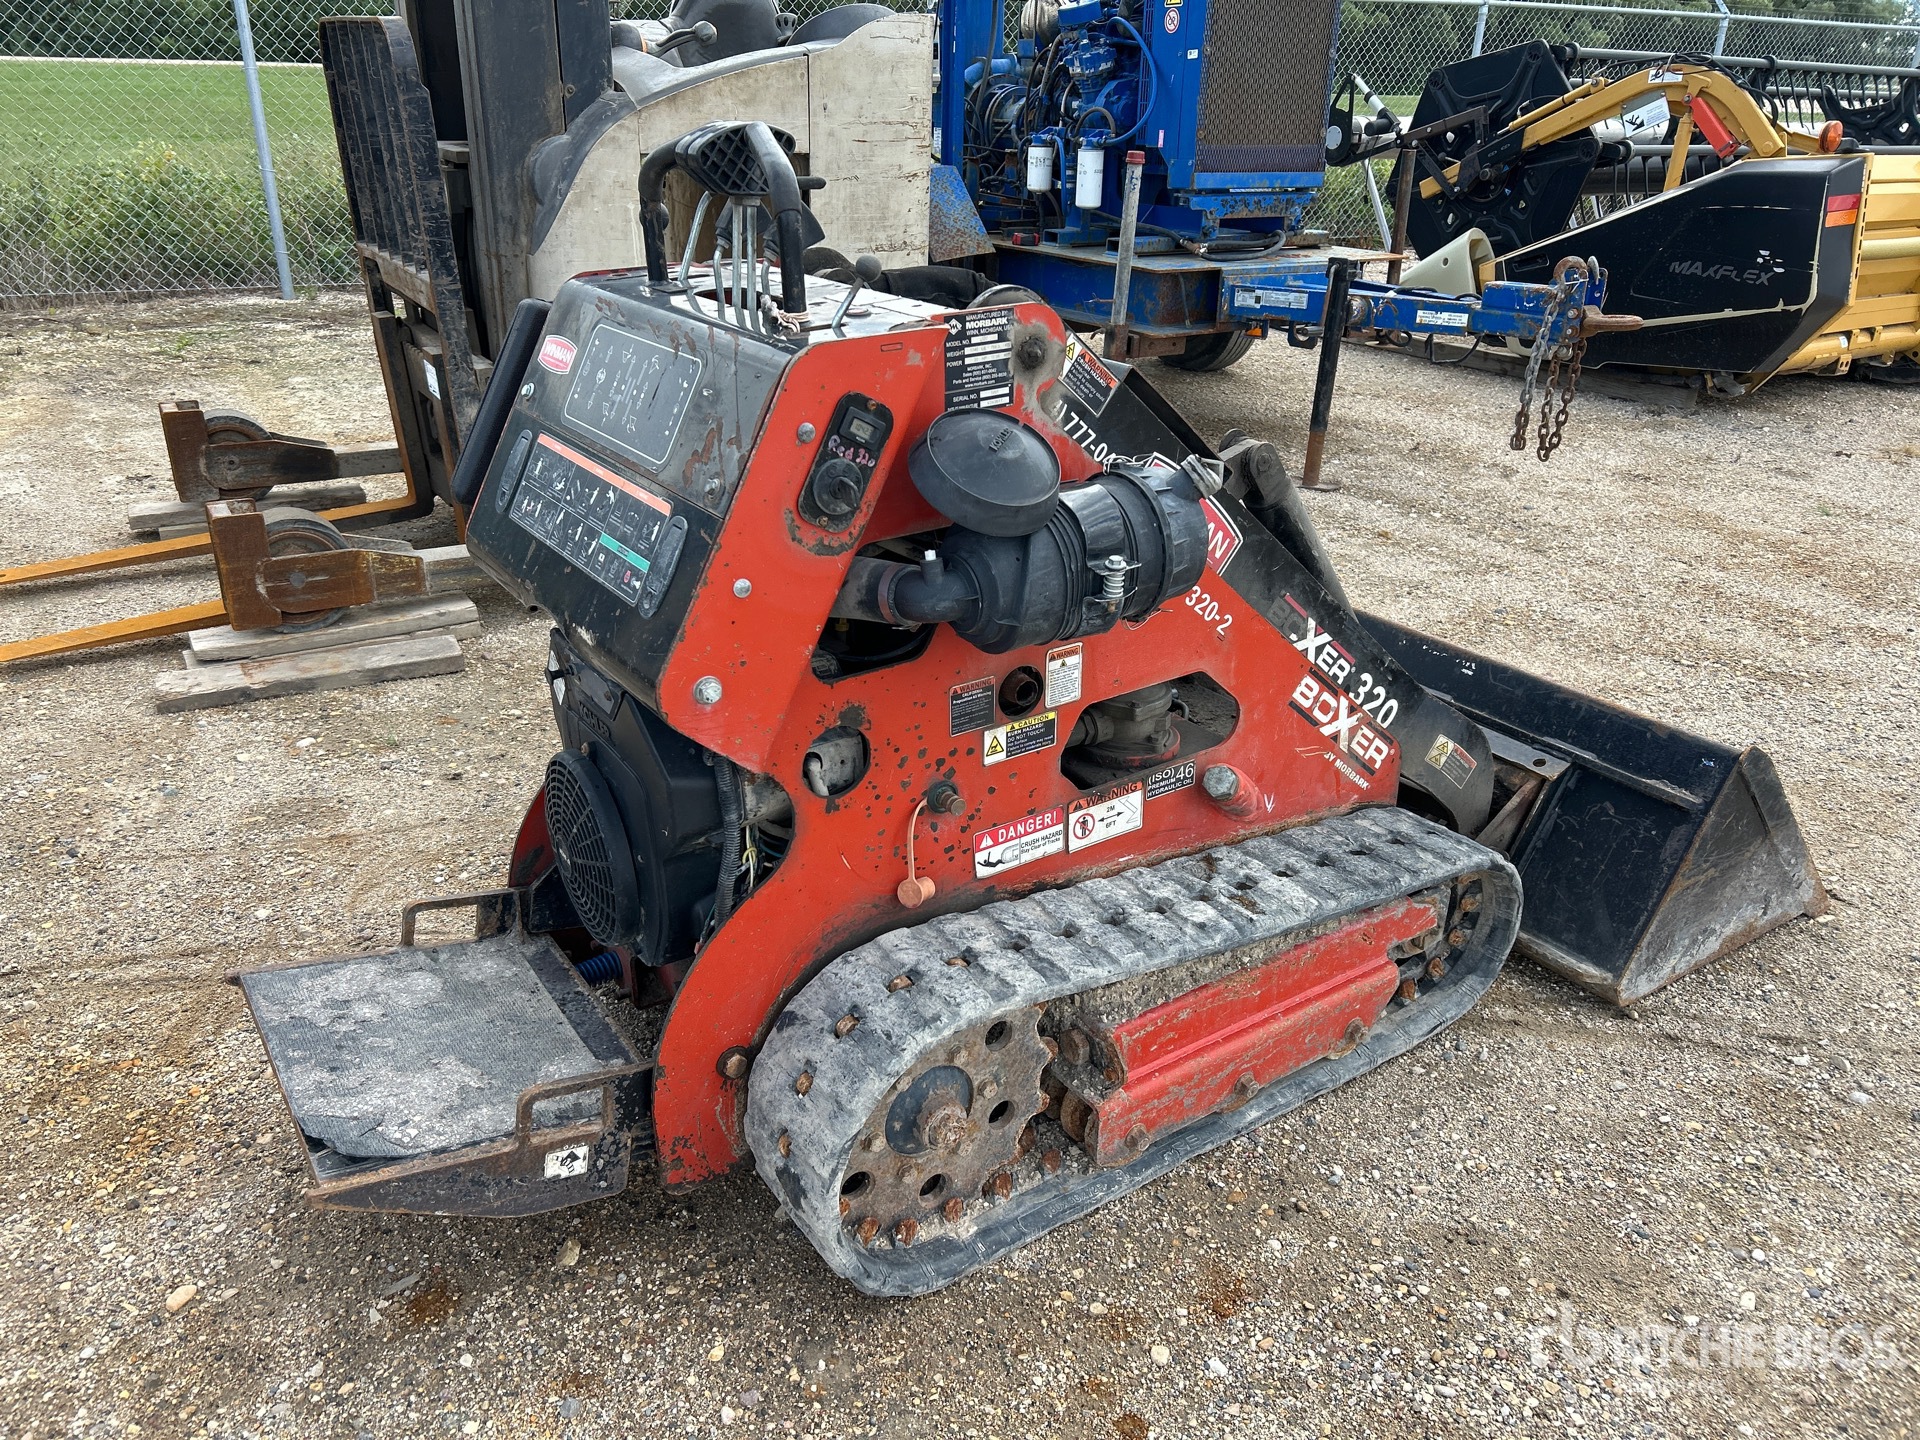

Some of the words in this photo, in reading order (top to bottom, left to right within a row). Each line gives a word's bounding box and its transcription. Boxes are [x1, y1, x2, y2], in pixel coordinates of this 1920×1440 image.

[1669, 260, 1776, 286] MAXFLEX
[966, 311, 1001, 320] MANUFACTURED
[966, 317, 1008, 329] MORBARK
[946, 340, 961, 348] MODEL
[946, 349, 964, 357] WEIGHT
[1077, 356, 1091, 371] CRUSH
[1087, 355, 1113, 385] WARNING
[828, 435, 854, 461] Red
[856, 448, 876, 467] 320
[1185, 585, 1233, 636] 320-2
[1056, 647, 1079, 659] WARNING
[959, 680, 992, 692] WARNING
[962, 688, 983, 698] CALIFORNIA
[1349, 672, 1399, 729] 320
[578, 701, 612, 739] KOHLER
[1018, 714, 1049, 728] CAUTION
[1291, 674, 1390, 769] BOXER
[1007, 729, 1022, 737] BURN
[1022, 723, 1044, 732] HAZARD!
[1027, 728, 1045, 736] TOUCH!
[1148, 767, 1175, 785] (ISO)
[1176, 763, 1194, 780] 46
[1334, 758, 1369, 791] MORBARK
[1147, 777, 1176, 790] PREMIUM
[1147, 781, 1182, 797] HYDRAULIC
[1086, 783, 1138, 807] WARNING
[1106, 805, 1115, 813] 2M
[998, 811, 1057, 842] DANGER!
[1105, 820, 1117, 829] 6FT
[1020, 837, 1040, 849] CRUSH
[1040, 829, 1063, 842] HAZARD
[1030, 843, 1042, 851] Clear
